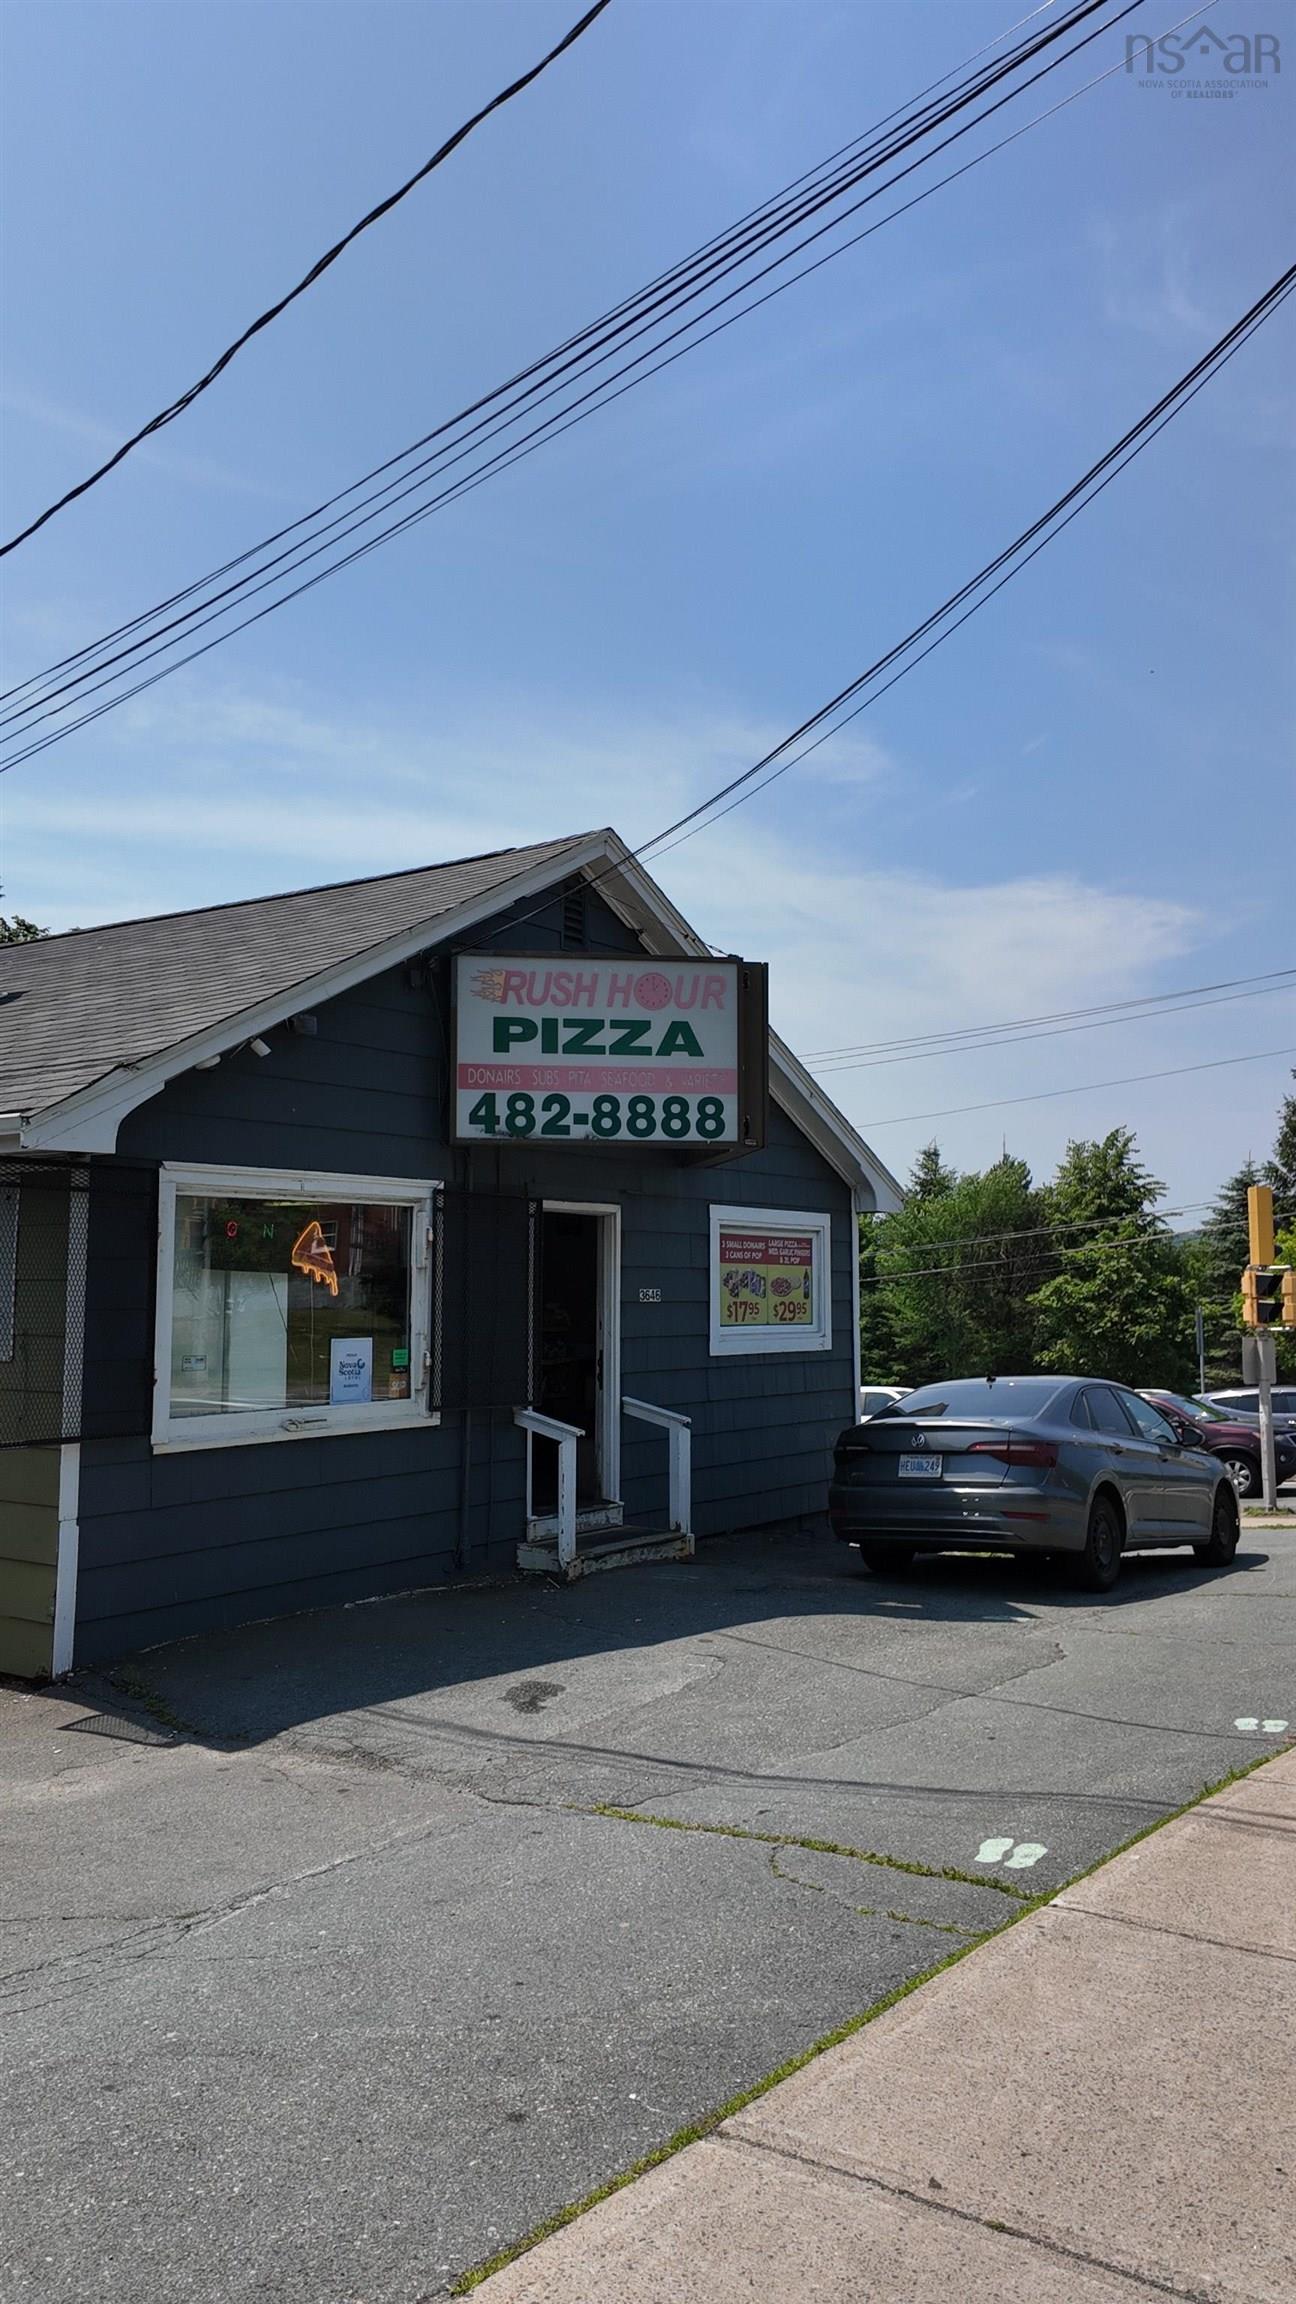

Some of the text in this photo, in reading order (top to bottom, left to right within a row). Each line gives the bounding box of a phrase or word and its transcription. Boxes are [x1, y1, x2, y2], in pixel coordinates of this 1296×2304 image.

[500, 970, 728, 1011] RUSH HOUR
[493, 1016, 704, 1057] PIZZA
[467, 1068, 727, 1089] DONAIRS SUBS PITA SEAFOOD & ARIE
[468, 1092, 726, 1139] 482-8888
[726, 1240, 743, 1249] SMALL
[743, 1241, 767, 1250] DONAIRS
[751, 1251, 763, 1260] POP
[339, 1360, 357, 1369] Nova
